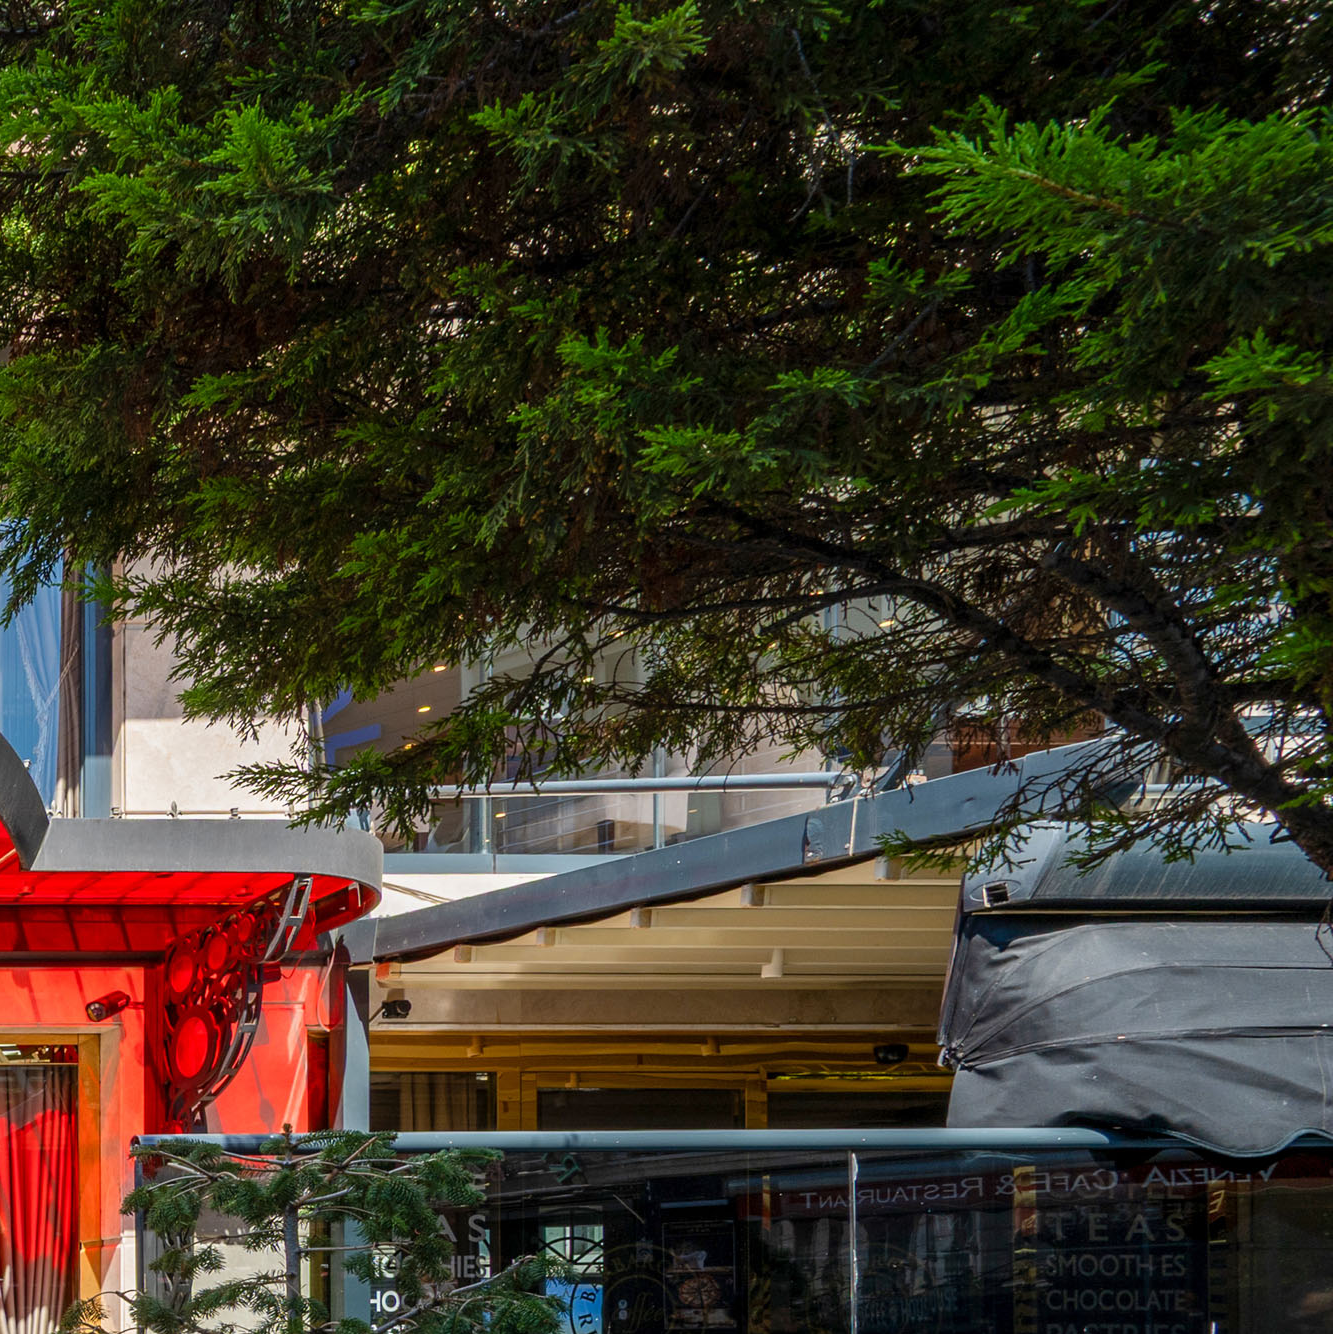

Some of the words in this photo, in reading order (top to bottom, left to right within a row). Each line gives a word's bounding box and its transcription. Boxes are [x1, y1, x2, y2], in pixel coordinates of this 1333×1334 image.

[1047, 1212, 1187, 1242] TEAS
[1045, 1253, 1187, 1277] SMOOTHES
[1045, 1289, 1187, 1313] CHOCOLATE
